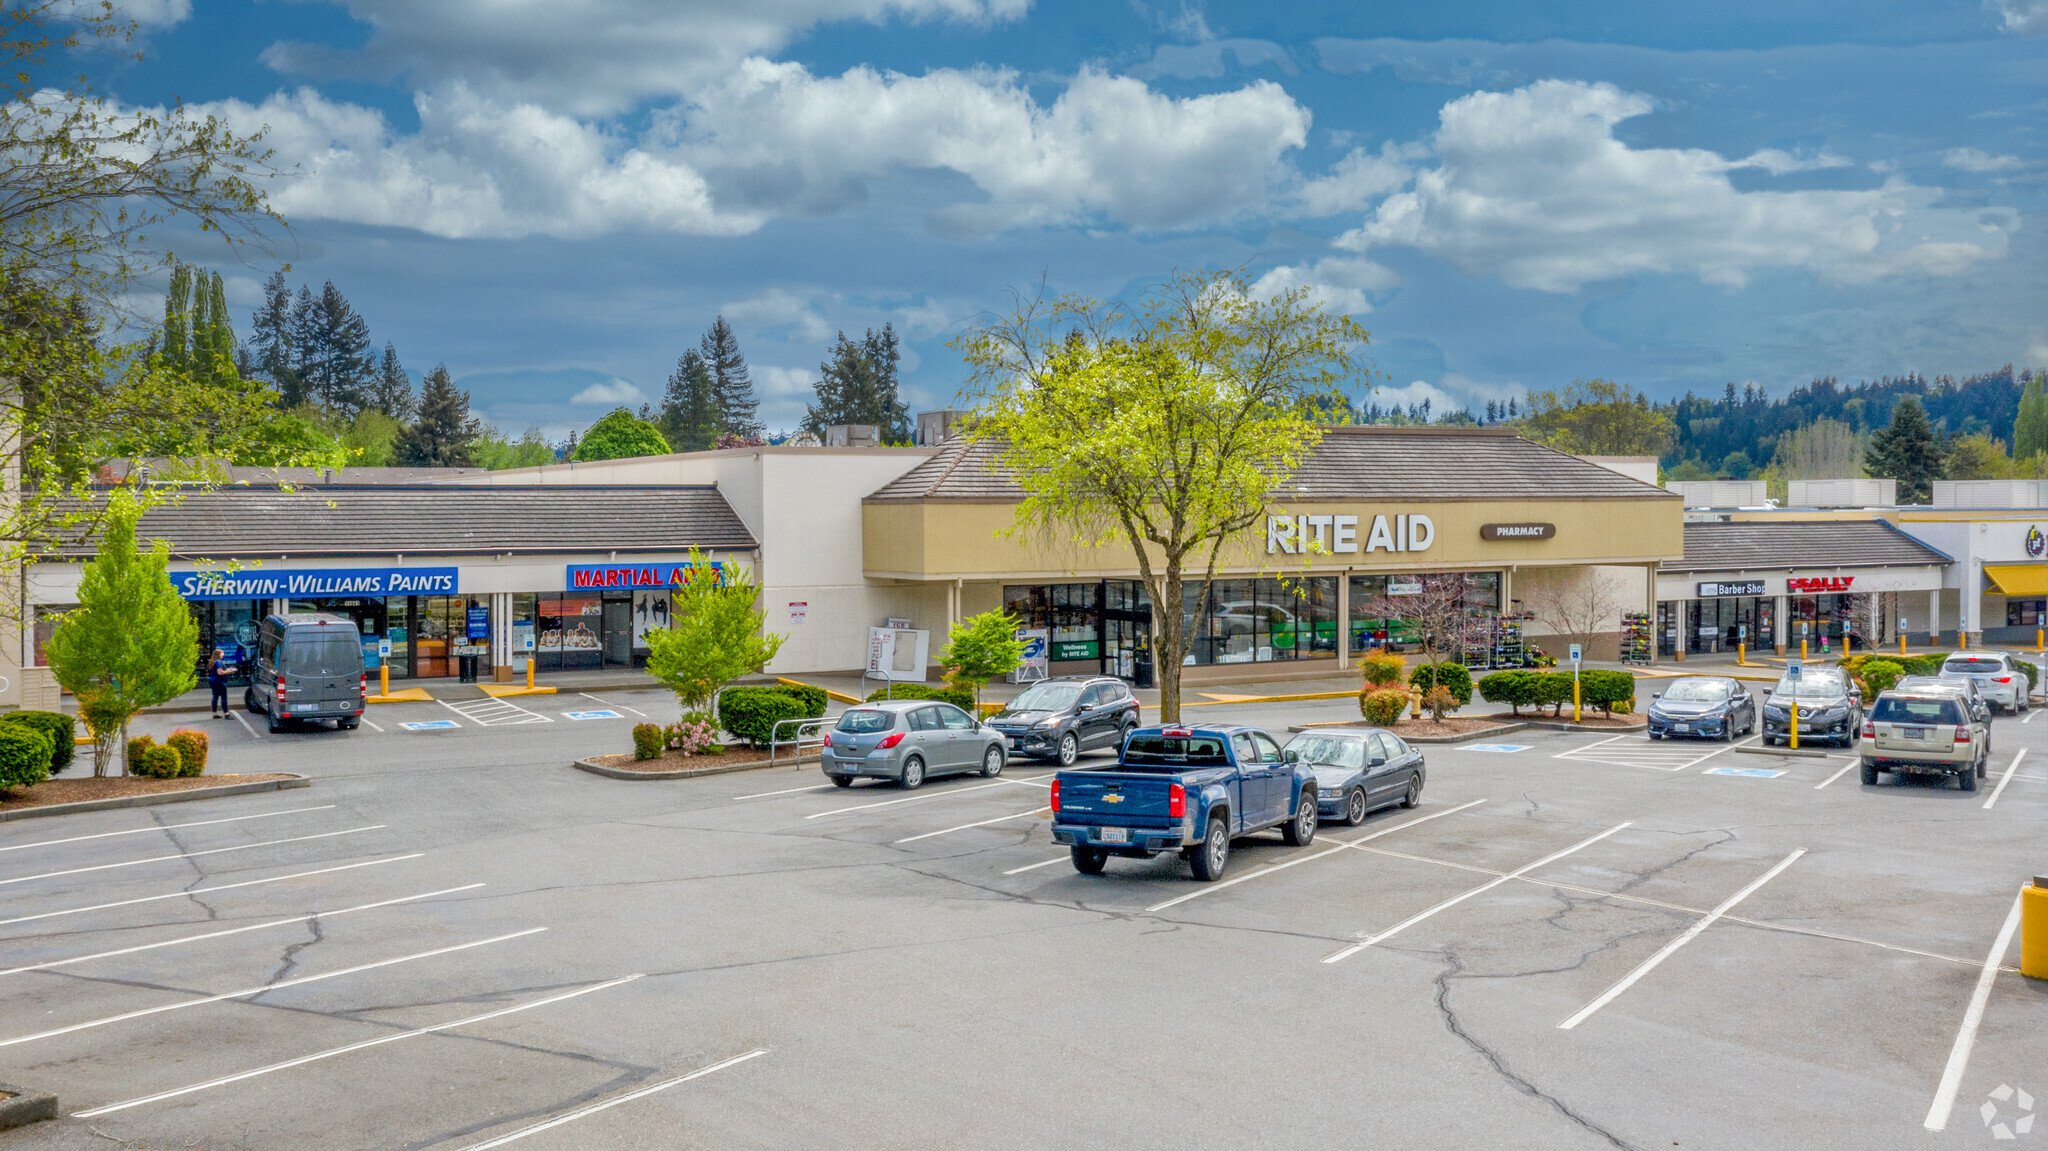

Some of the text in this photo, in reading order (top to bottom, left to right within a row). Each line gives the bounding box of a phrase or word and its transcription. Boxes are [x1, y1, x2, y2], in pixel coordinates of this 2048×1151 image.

[1266, 514, 1435, 554] RITE AID
[1496, 526, 1544, 537] PHARMACY
[181, 573, 453, 596] SHERWIN-WILLIAMS PAINTS
[574, 567, 721, 587] MARTIAL ARS
[1797, 576, 1855, 589] SALLY
[1718, 584, 1746, 595] Barber
[1746, 582, 1766, 595] Shop
